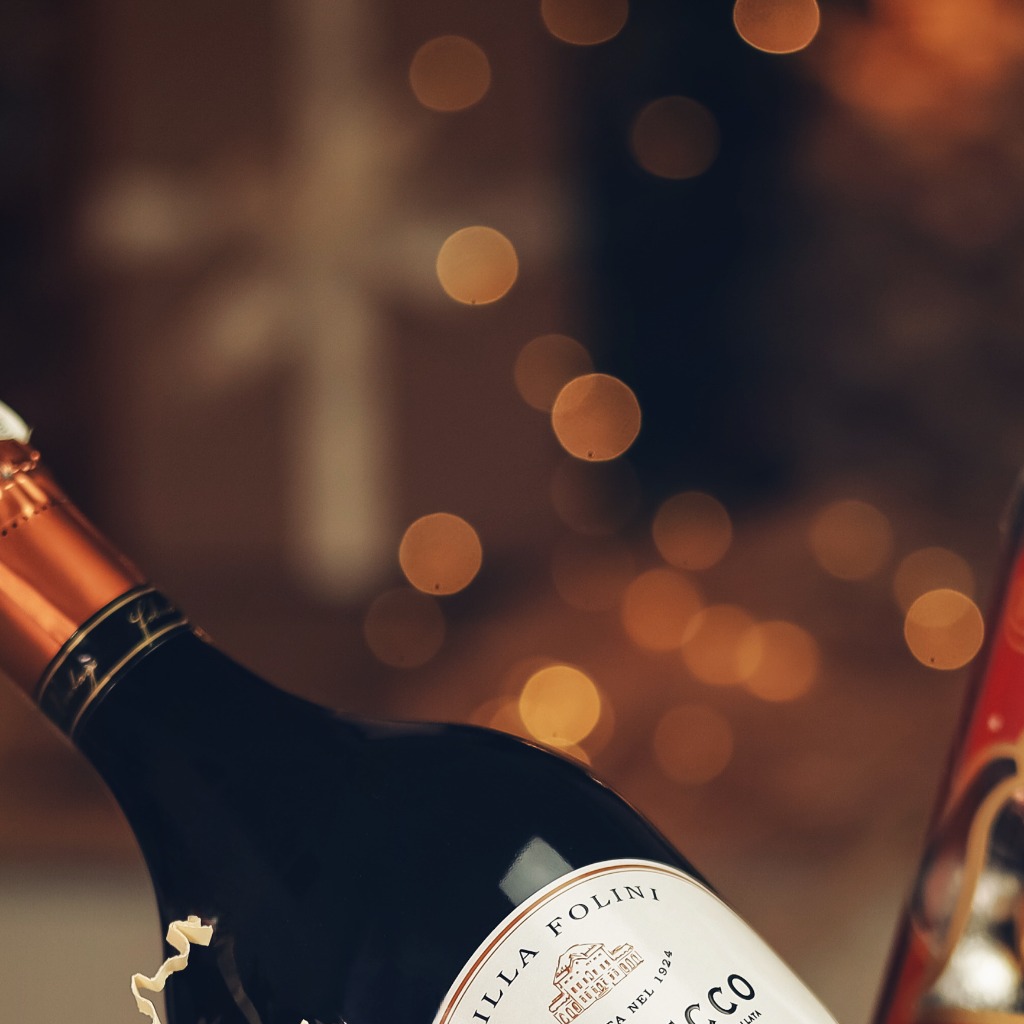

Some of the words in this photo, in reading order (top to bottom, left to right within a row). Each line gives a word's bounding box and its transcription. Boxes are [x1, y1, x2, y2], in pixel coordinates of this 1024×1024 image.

[546, 886, 660, 937] FOLINI
[627, 989, 655, 1014] NEL
[654, 950, 673, 984] 1924
